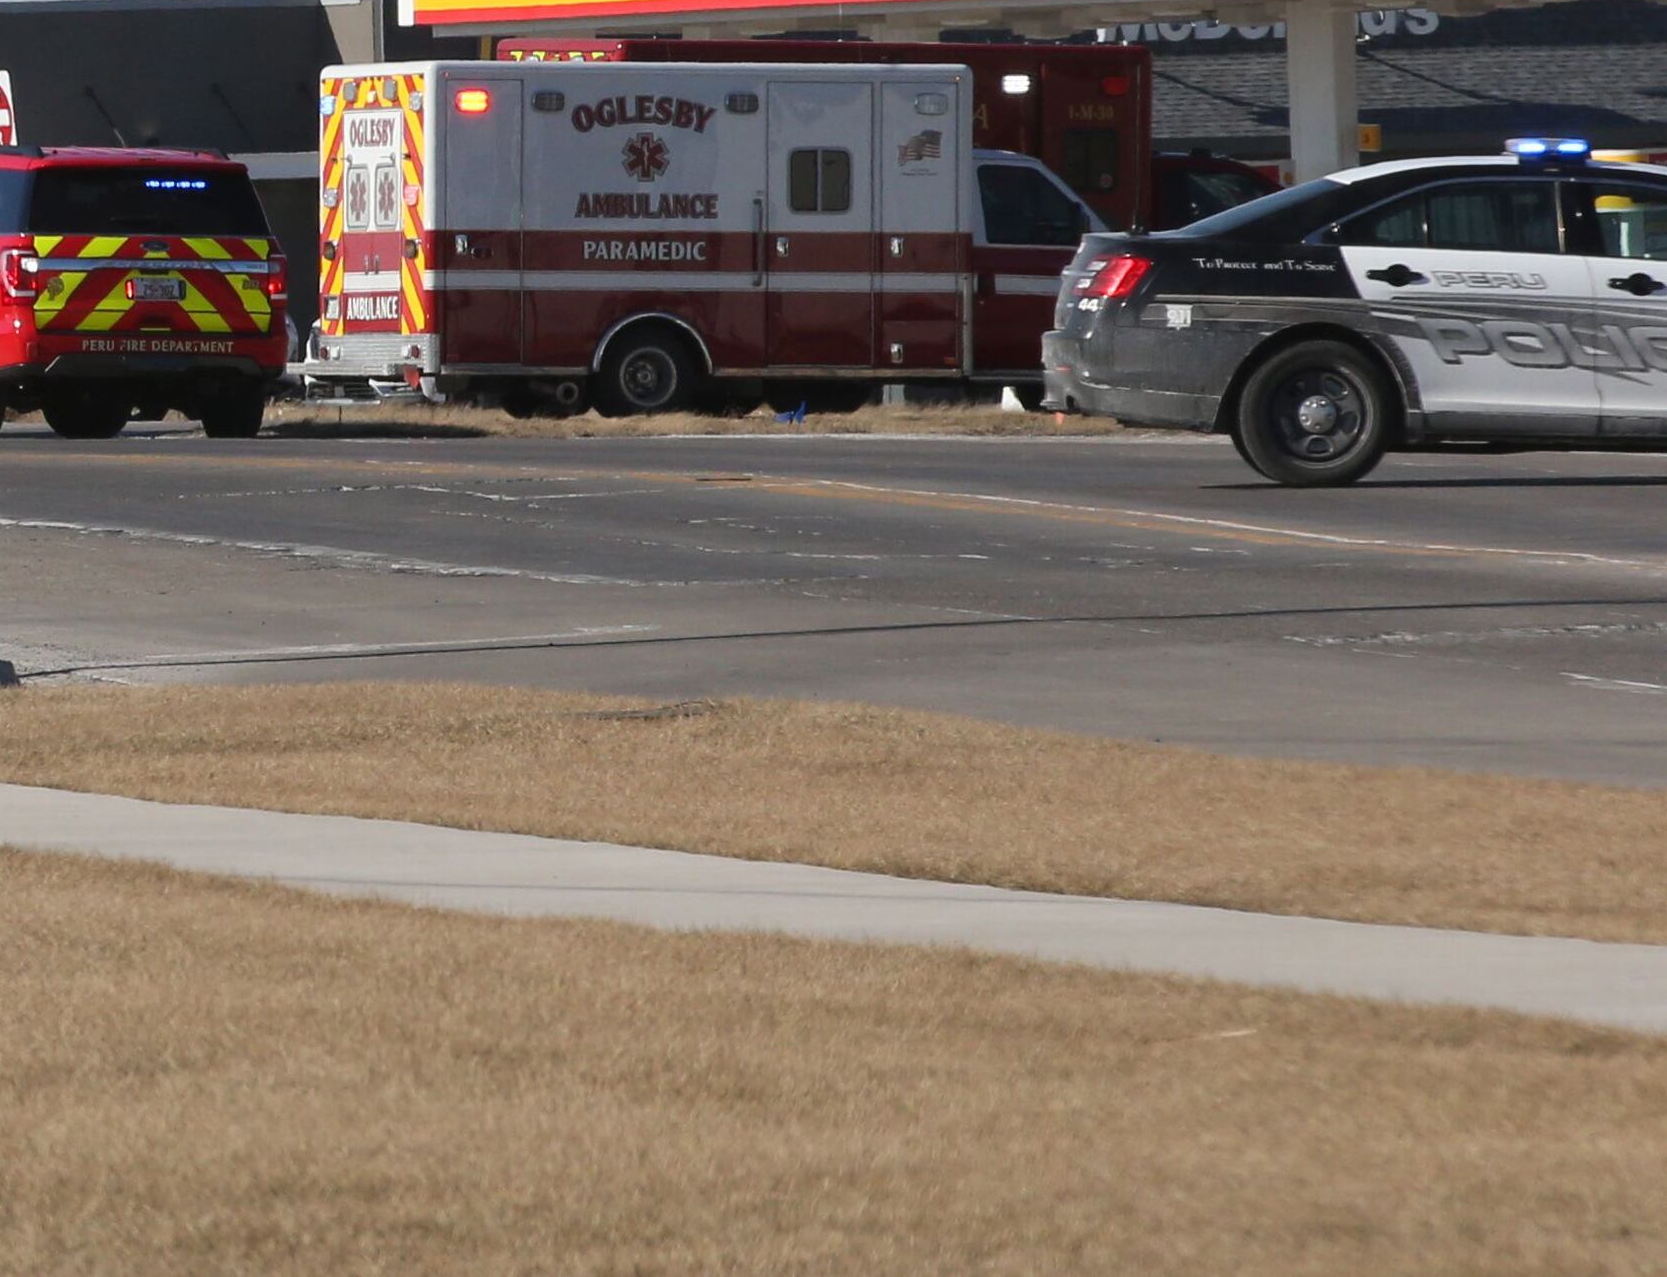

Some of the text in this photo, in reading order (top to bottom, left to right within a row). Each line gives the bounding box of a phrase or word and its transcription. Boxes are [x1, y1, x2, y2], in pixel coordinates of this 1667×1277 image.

[571, 95, 718, 134] OGLESBY
[350, 118, 395, 147] OGLESBY
[574, 193, 719, 219] AMBULANCE
[584, 241, 707, 261] PARAMEDIC
[1431, 271, 1548, 290] PERU
[347, 297, 398, 320] AMBULANCE
[1078, 297, 1098, 312] 44
[82, 339, 235, 354] PERU FIRE DEPARTMENT
[1417, 318, 1667, 372] POLIC
